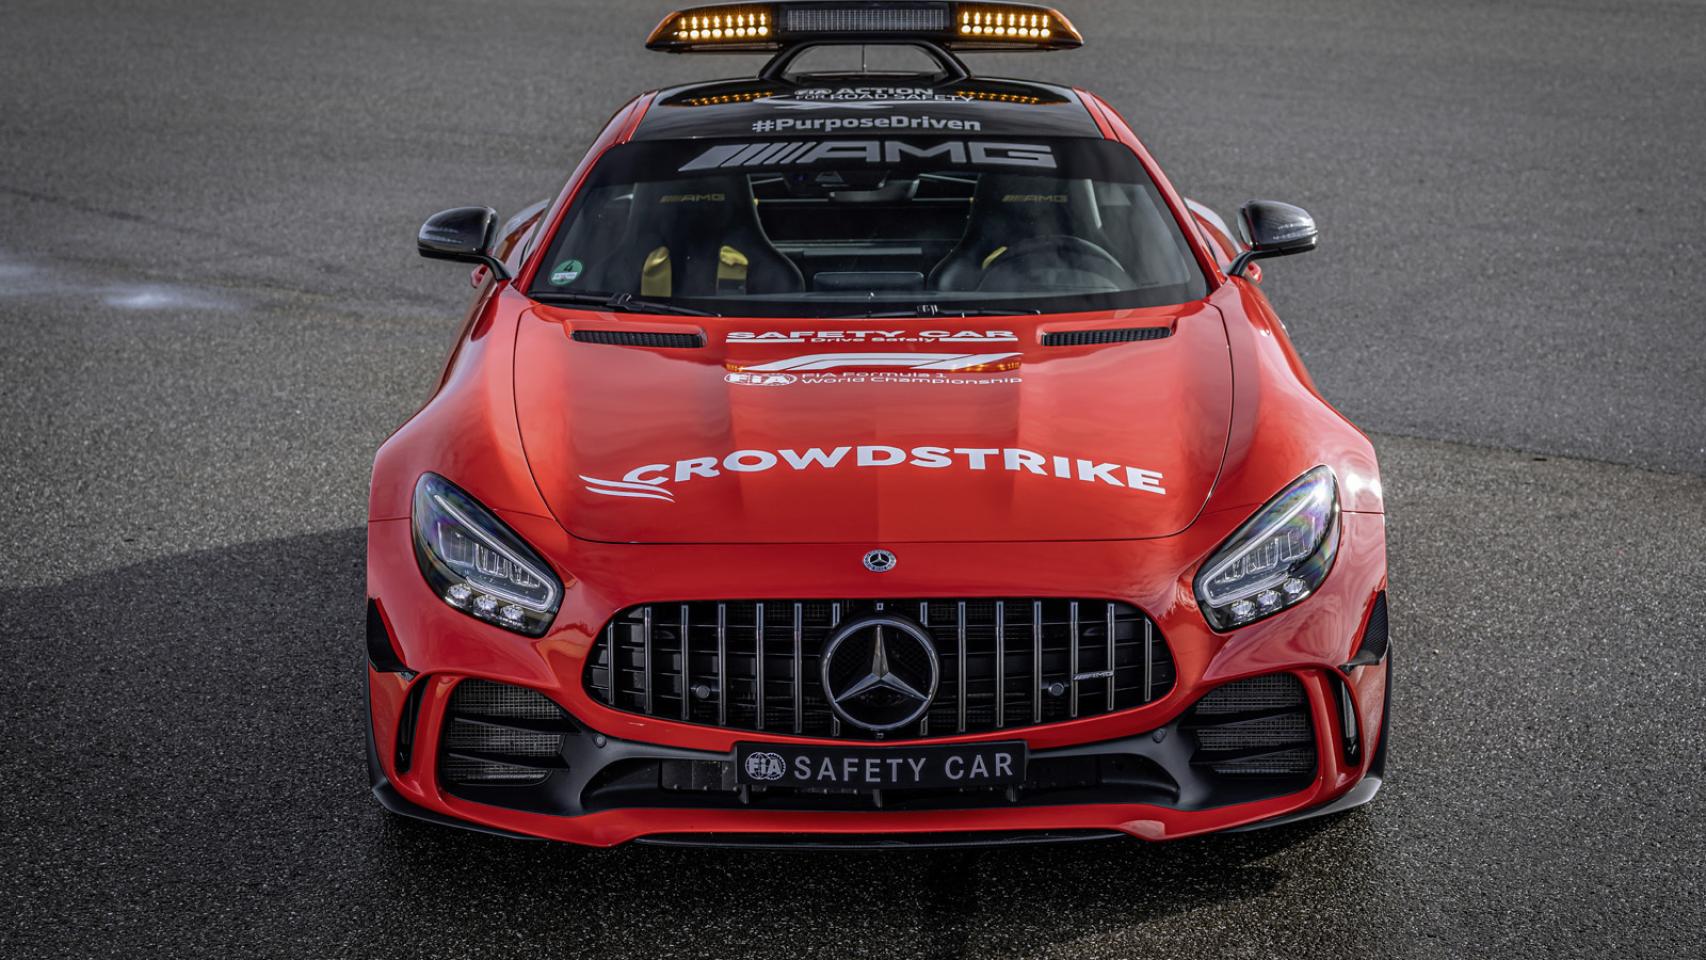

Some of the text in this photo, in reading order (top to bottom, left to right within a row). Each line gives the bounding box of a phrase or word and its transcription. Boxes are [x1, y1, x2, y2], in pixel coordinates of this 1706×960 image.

[836, 87, 934, 95] ACTION
[893, 94, 976, 102] SAFETY
[752, 116, 981, 133] #PurposeDriven
[795, 141, 1058, 168] AMG
[679, 193, 726, 202] AMG
[1023, 194, 1069, 202] AMG
[726, 330, 1017, 339] SAFETY CAR
[726, 373, 794, 385] FIA
[870, 377, 1023, 385] Championship
[623, 446, 1167, 495] CROWDSTRIKE
[794, 755, 927, 783] SAFETY
[944, 752, 1014, 780] CAR
